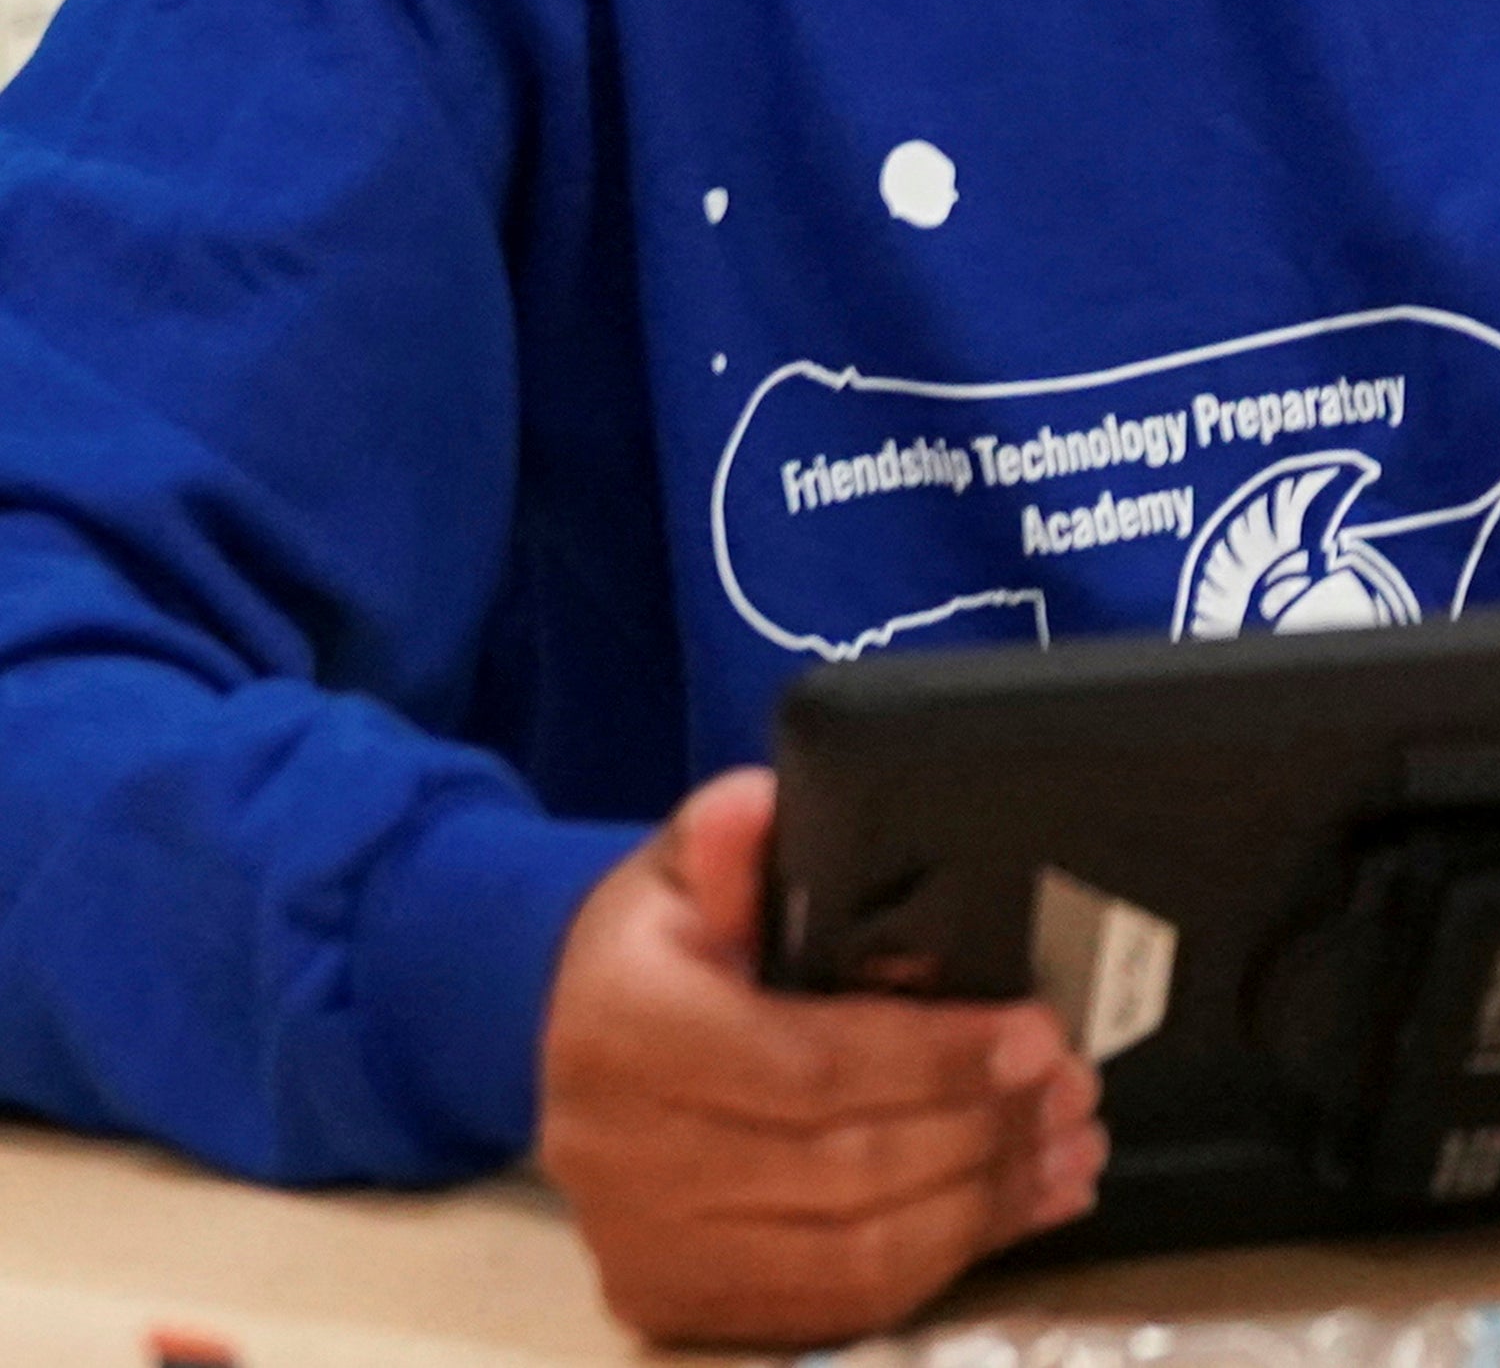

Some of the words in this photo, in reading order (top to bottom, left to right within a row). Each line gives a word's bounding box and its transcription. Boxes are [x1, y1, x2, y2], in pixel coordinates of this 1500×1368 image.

[782, 438, 972, 513] Friendship
[973, 411, 1186, 485] Technology
[1192, 377, 1404, 447] Preparatory
[1023, 486, 1193, 554] Academy
